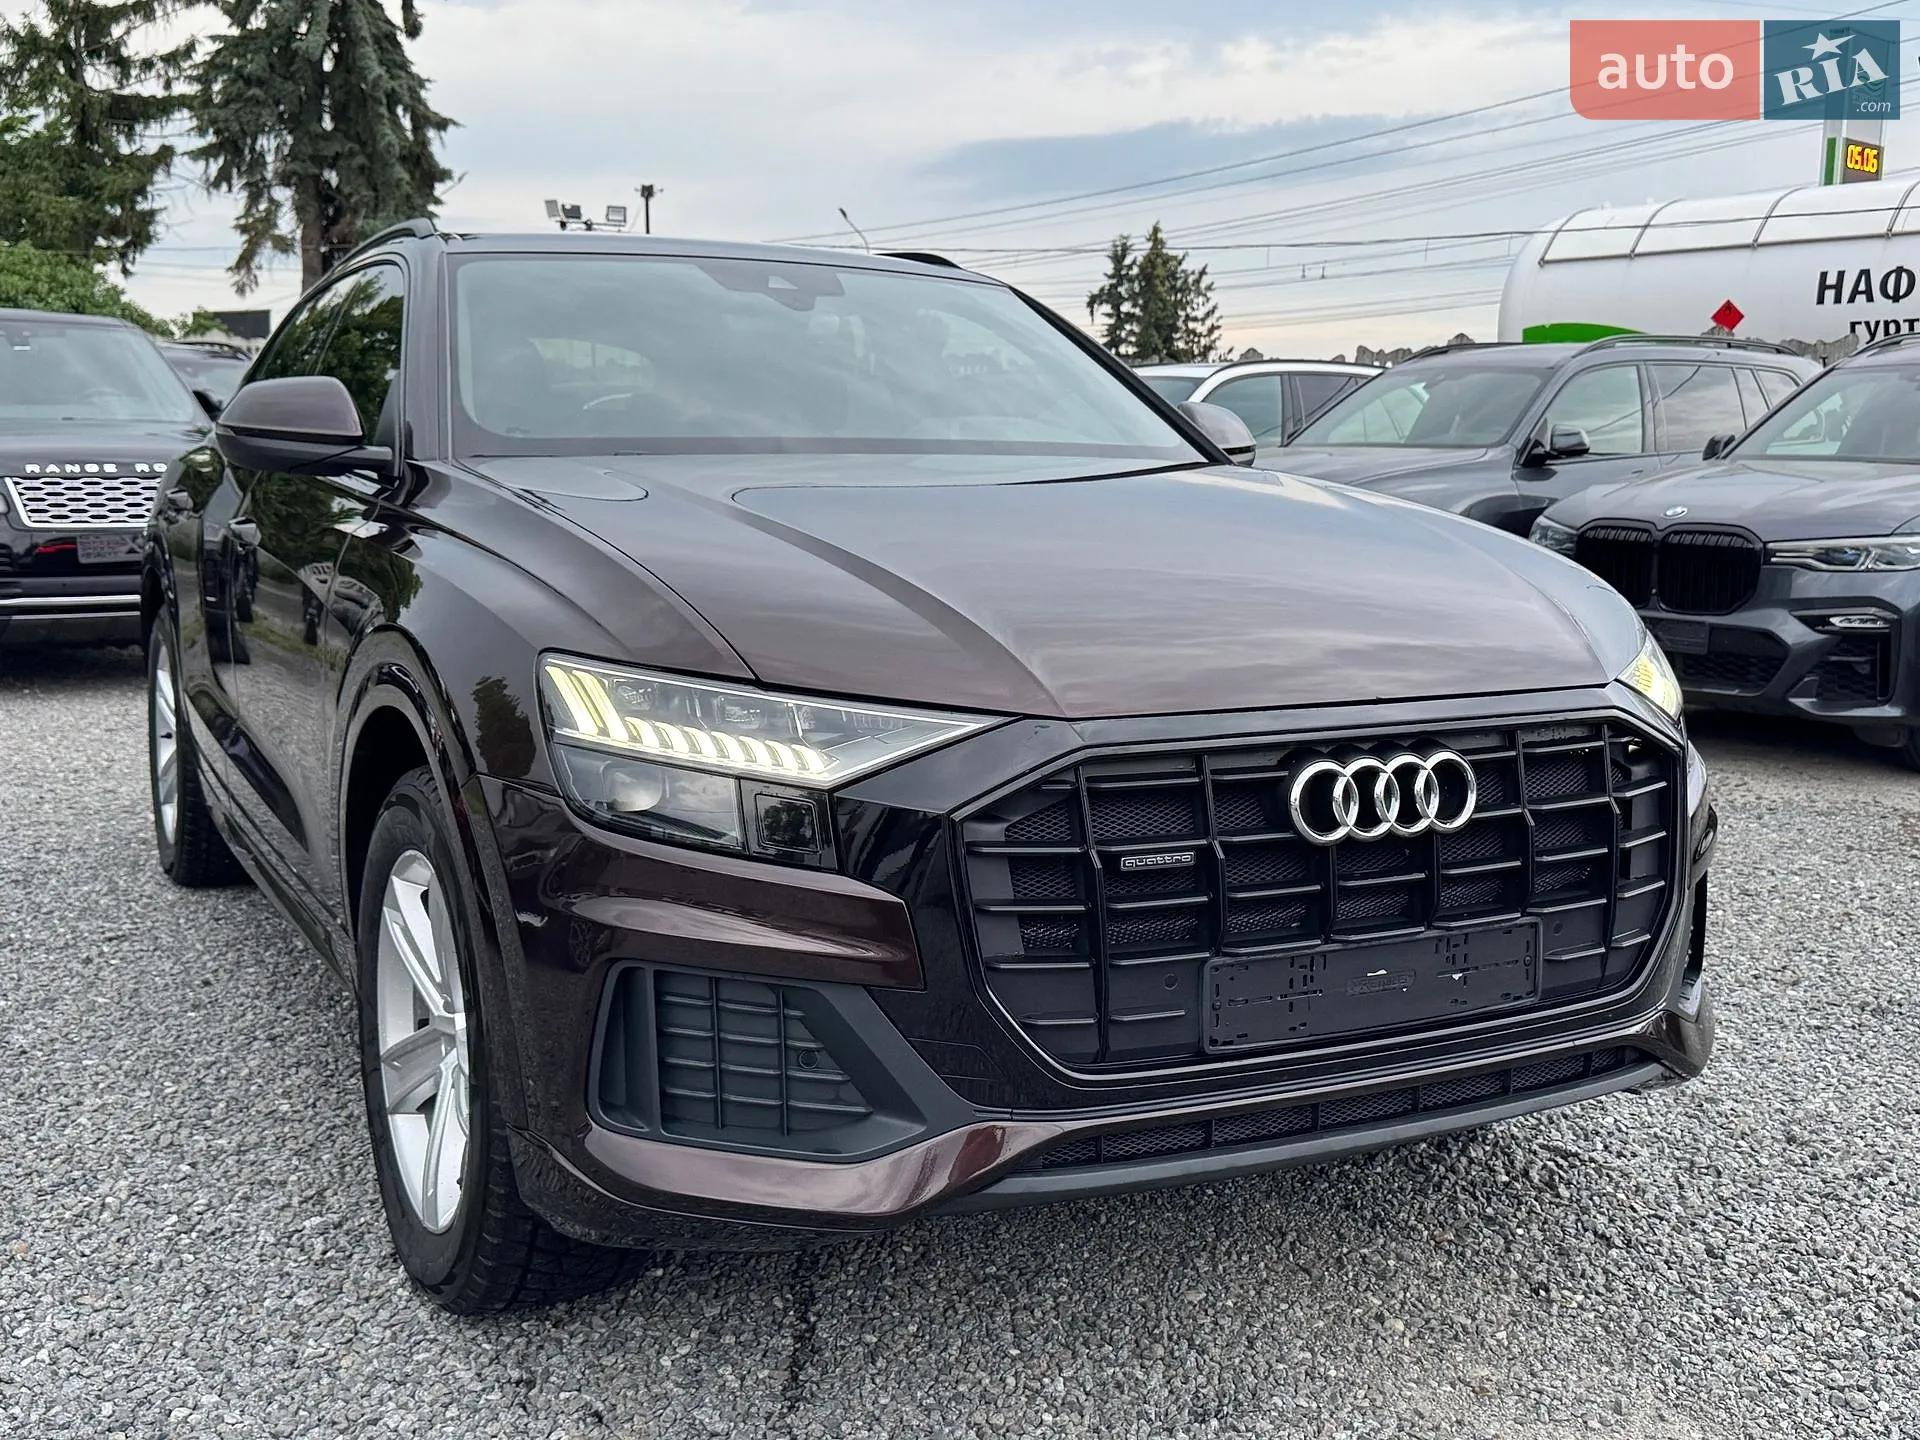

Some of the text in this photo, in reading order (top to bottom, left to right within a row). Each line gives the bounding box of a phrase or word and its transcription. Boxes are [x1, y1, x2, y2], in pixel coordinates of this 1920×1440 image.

[1815, 265, 1917, 306] НАФ
[24, 462, 119, 475] RANGE
[1125, 854, 1192, 869] quattro
